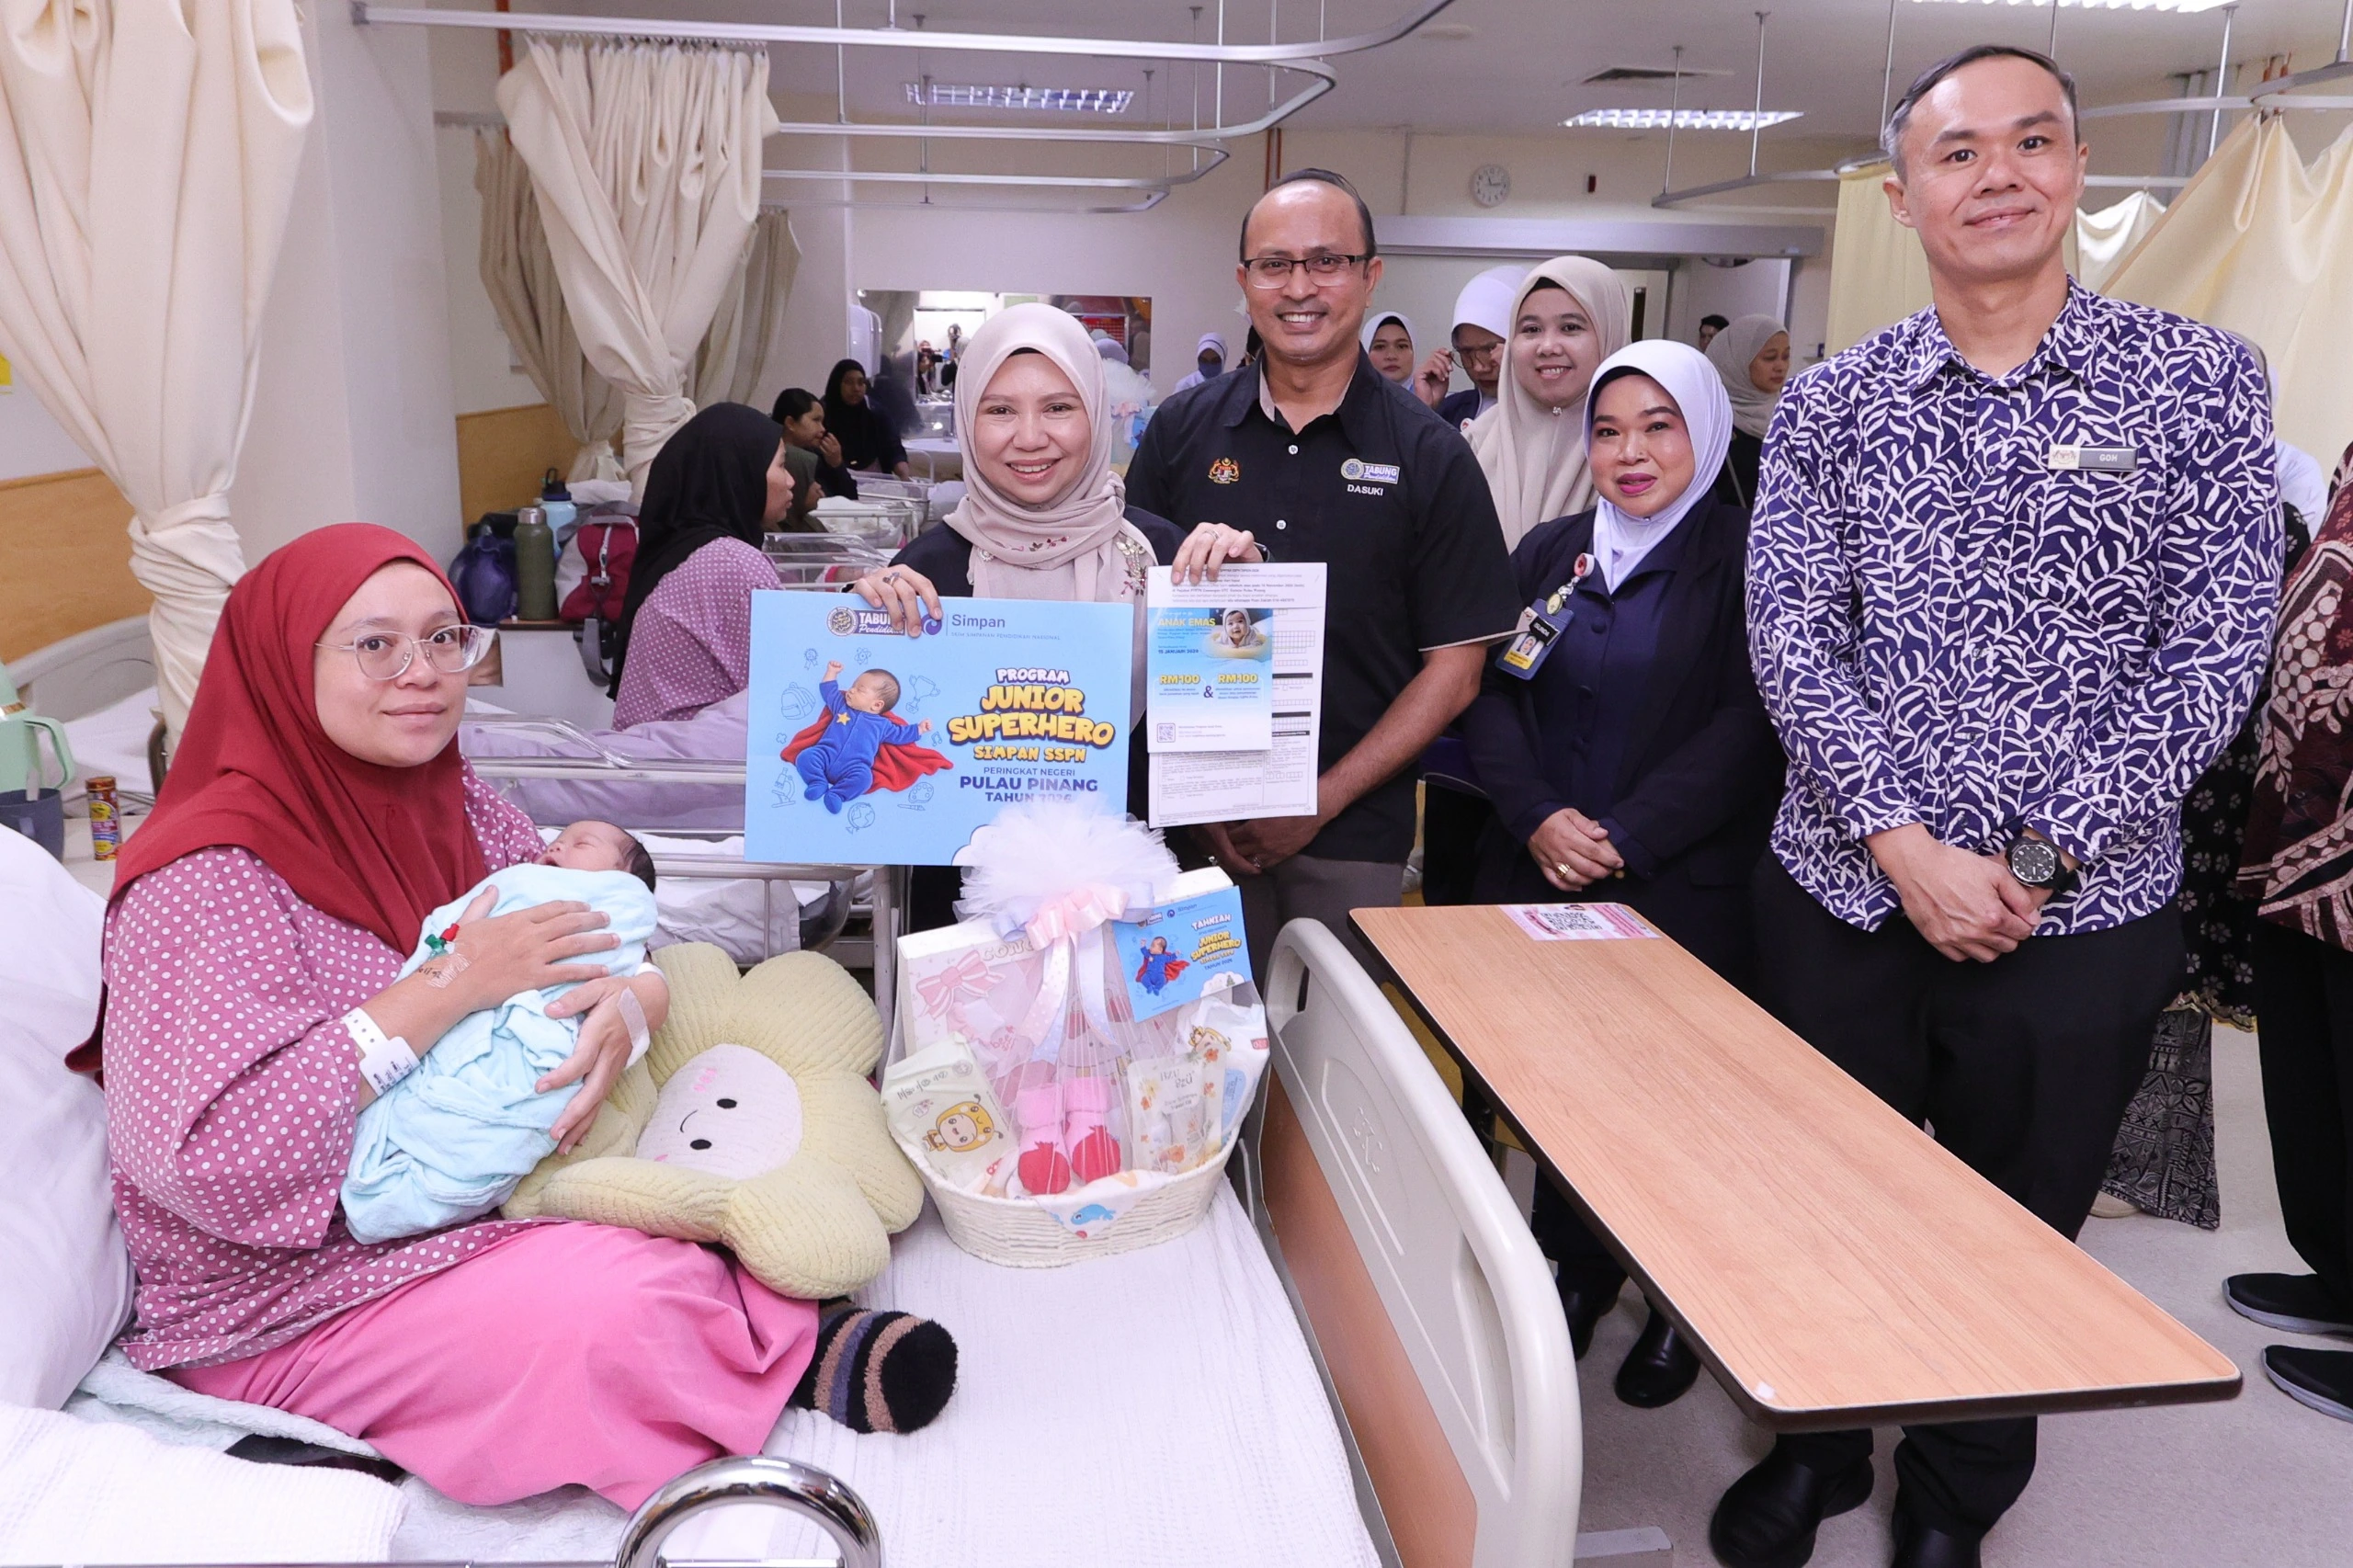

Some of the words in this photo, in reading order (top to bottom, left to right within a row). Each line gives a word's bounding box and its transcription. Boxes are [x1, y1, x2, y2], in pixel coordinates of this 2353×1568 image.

[2098, 453, 2119, 462] GOH
[1364, 465, 1397, 476] TABUNG
[1347, 483, 1384, 496] DASUKI
[858, 611, 892, 626] TABU
[951, 614, 1006, 631] Simpan
[1159, 618, 1186, 626] ANAK
[1188, 618, 1216, 626] EMAS
[996, 667, 1071, 685] PROGRAM
[1159, 675, 1200, 685] RM100
[1218, 674, 1258, 684] RM100
[1203, 685, 1213, 699] &
[980, 685, 1085, 715] JUNIOR
[947, 711, 1116, 749] SUPERHERO
[973, 745, 1040, 761] SIMPAN
[1043, 747, 1087, 763] SSPN
[983, 767, 1038, 776] PERINGKAT
[1040, 768, 1075, 777] NEGERI
[960, 776, 1022, 790] PULAU
[1027, 777, 1098, 792] PINANG
[985, 791, 1034, 803] TAHUN
[1191, 914, 1232, 931] TAHNIAH
[1199, 930, 1232, 949] JUNIOR
[1190, 938, 1242, 961] SUPERHERO
